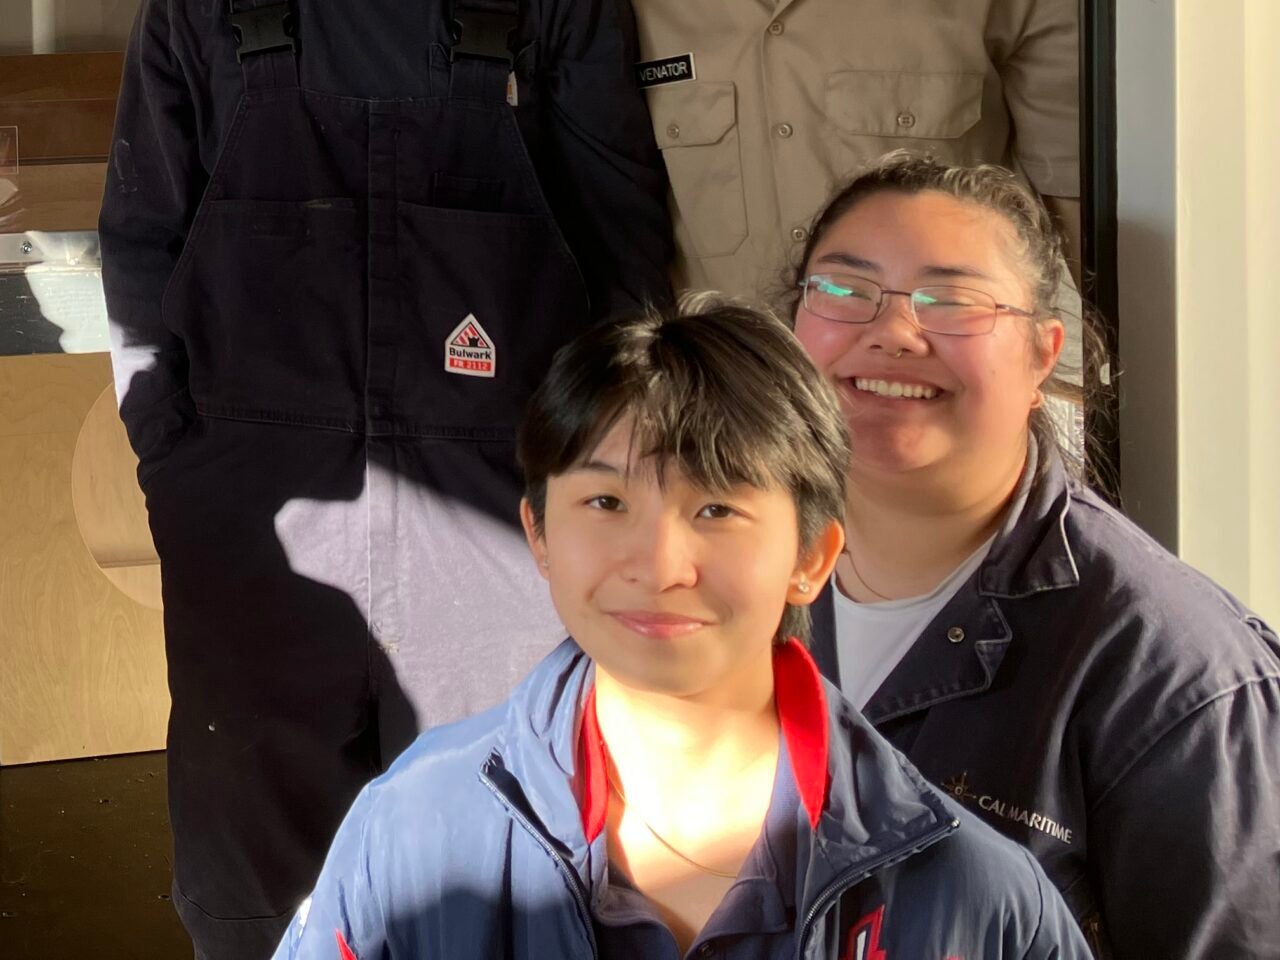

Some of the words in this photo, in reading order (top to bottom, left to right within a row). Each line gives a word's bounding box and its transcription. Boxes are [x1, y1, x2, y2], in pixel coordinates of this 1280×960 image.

[640, 62, 688, 81] VENATOR
[449, 347, 491, 360] Bulwark
[978, 795, 1006, 817] CAL
[1007, 803, 1073, 844] MARITIME
